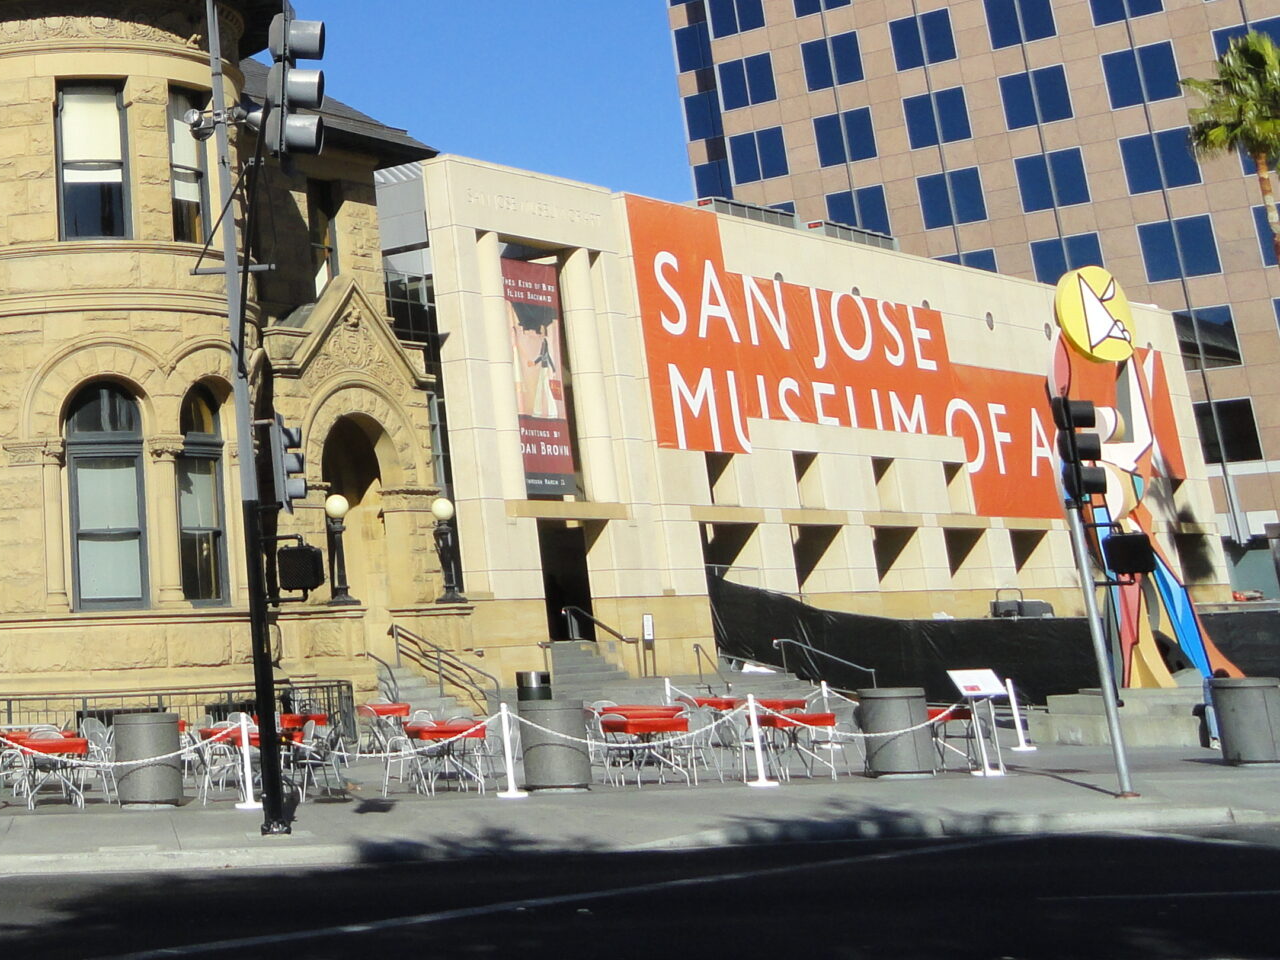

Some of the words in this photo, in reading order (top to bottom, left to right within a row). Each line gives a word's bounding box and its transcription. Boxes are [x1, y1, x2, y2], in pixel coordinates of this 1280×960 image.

[653, 251, 790, 350] SAN
[810, 287, 938, 371] JOSE
[540, 441, 569, 456] BROWN
[945, 398, 1012, 475] OF
